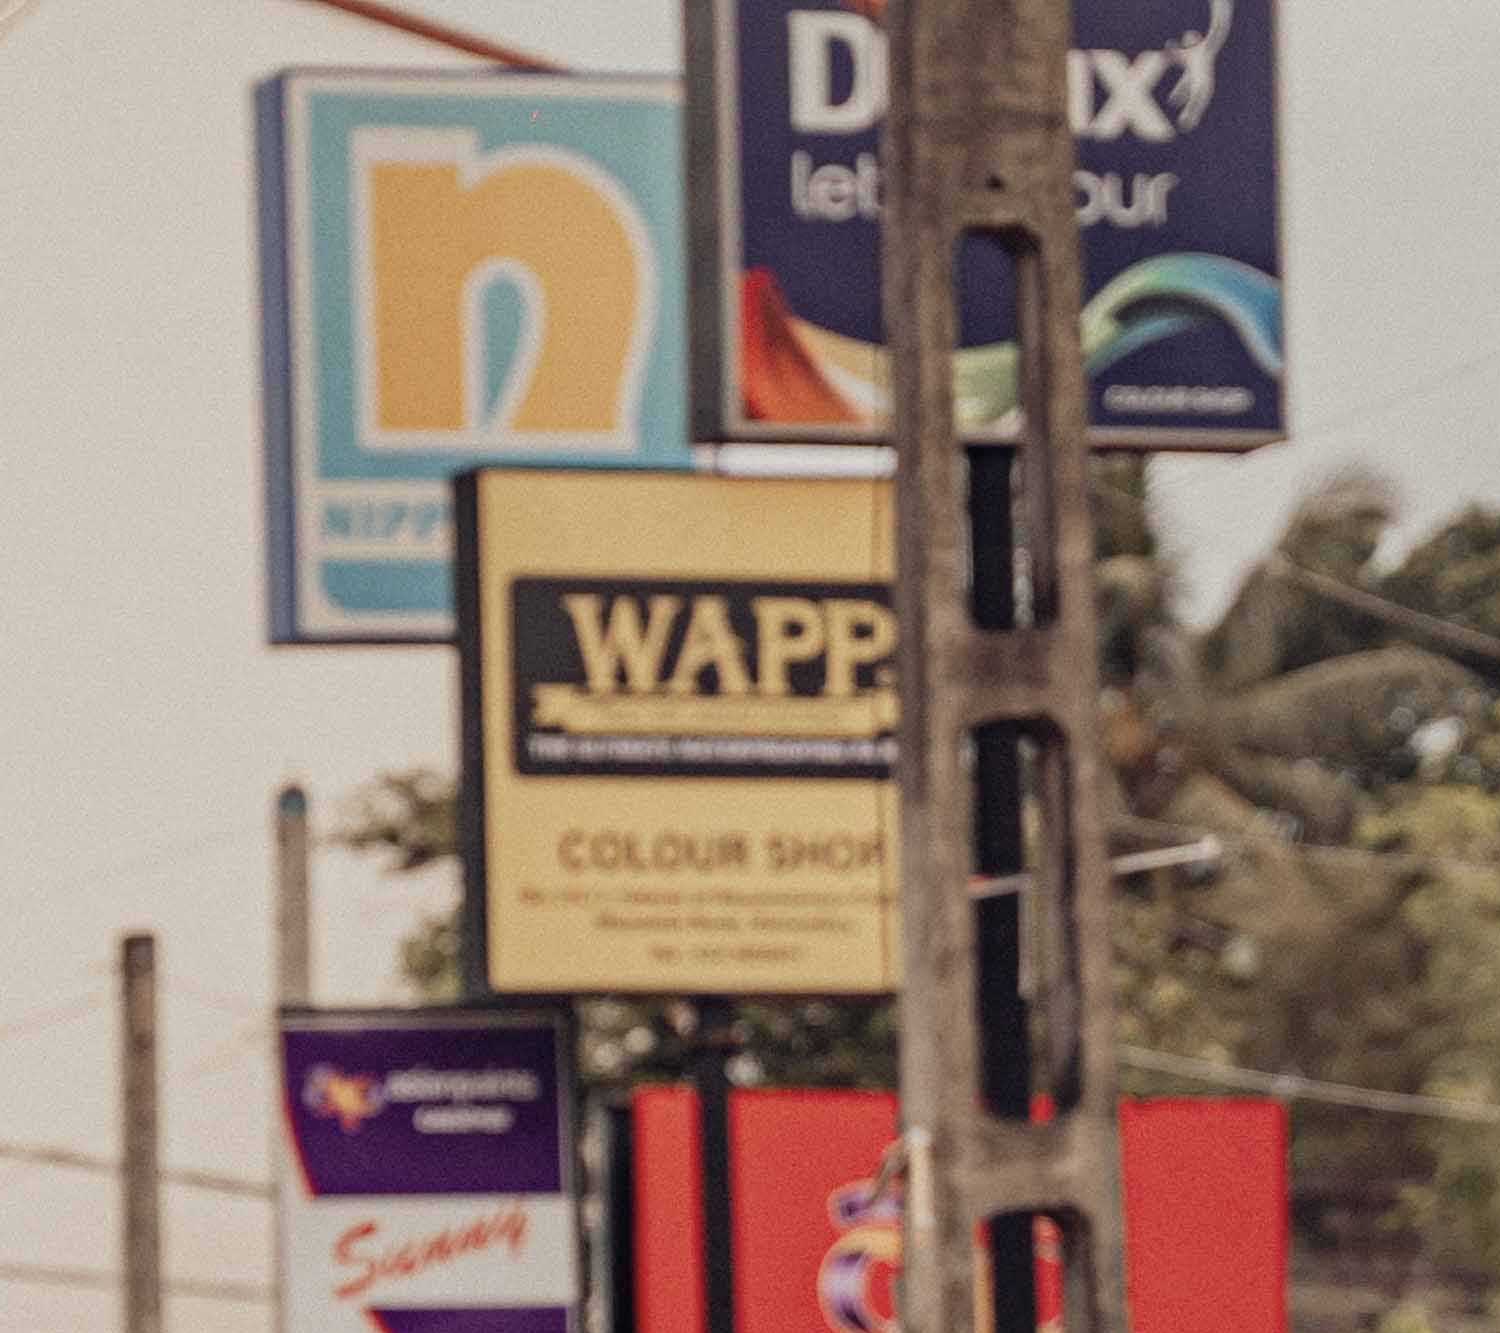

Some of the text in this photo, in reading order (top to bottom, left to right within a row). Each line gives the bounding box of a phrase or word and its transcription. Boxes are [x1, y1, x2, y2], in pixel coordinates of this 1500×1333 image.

[322, 500, 455, 541] NIPP
[561, 592, 897, 696] WAPP
[556, 828, 750, 872] COLOUR
